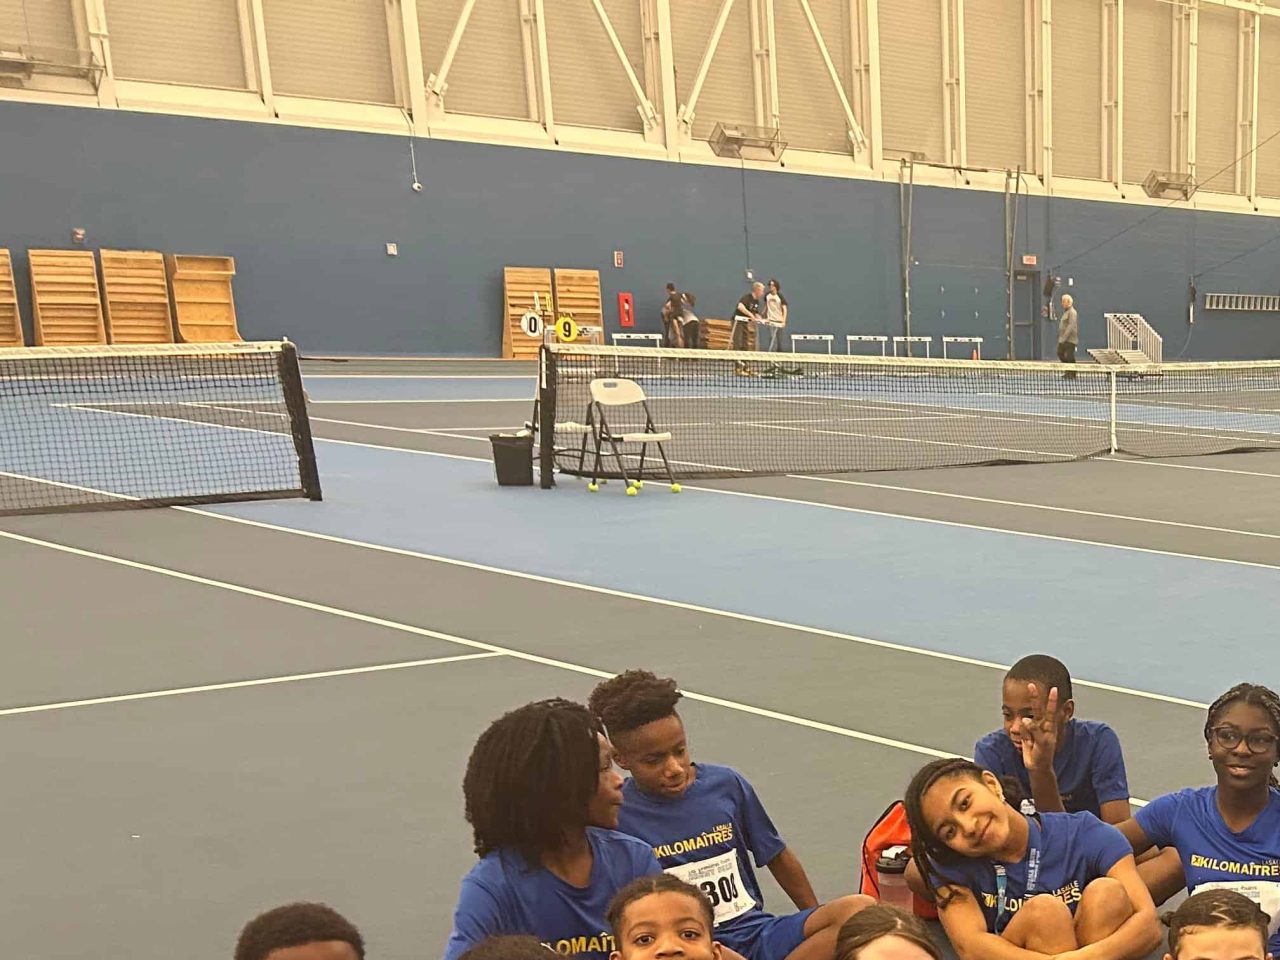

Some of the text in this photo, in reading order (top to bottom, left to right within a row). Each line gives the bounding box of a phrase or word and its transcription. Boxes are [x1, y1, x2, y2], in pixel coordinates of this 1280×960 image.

[529, 316, 537, 333] 0
[563, 321, 571, 337] 9
[655, 829, 733, 858] KILOMAÎTRES
